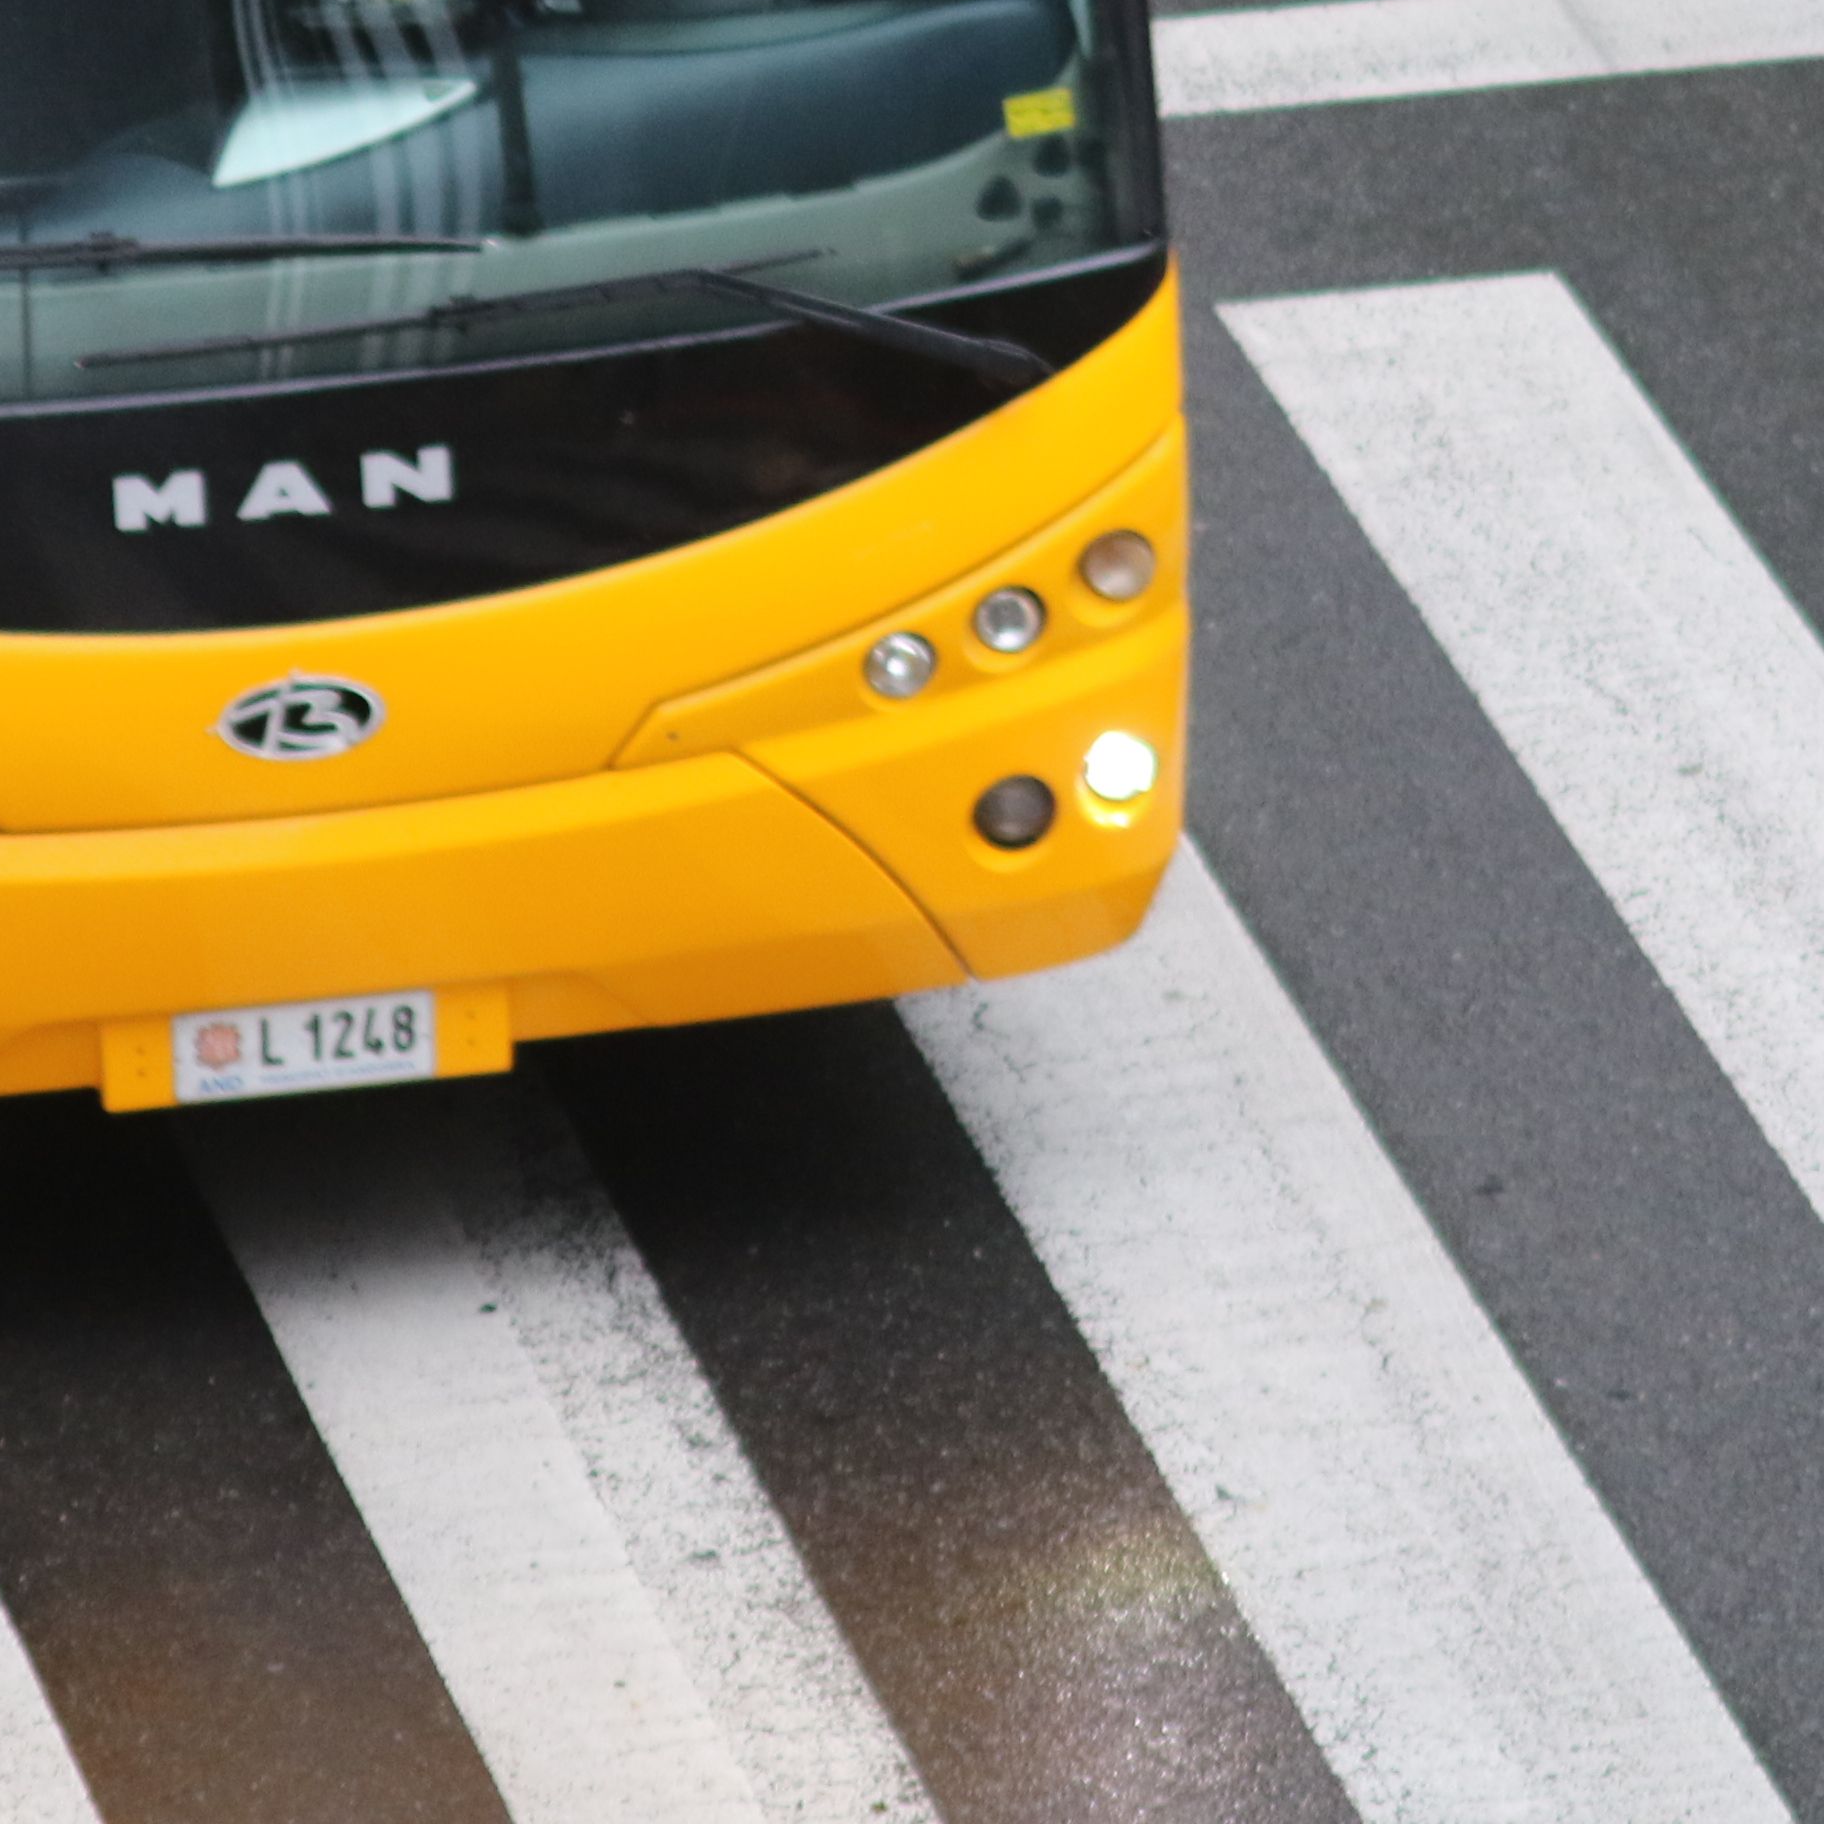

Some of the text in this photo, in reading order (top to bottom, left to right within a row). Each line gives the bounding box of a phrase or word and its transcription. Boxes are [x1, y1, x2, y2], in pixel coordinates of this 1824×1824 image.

[112, 444, 452, 532] MAN
[259, 1005, 416, 1066] L 1248
